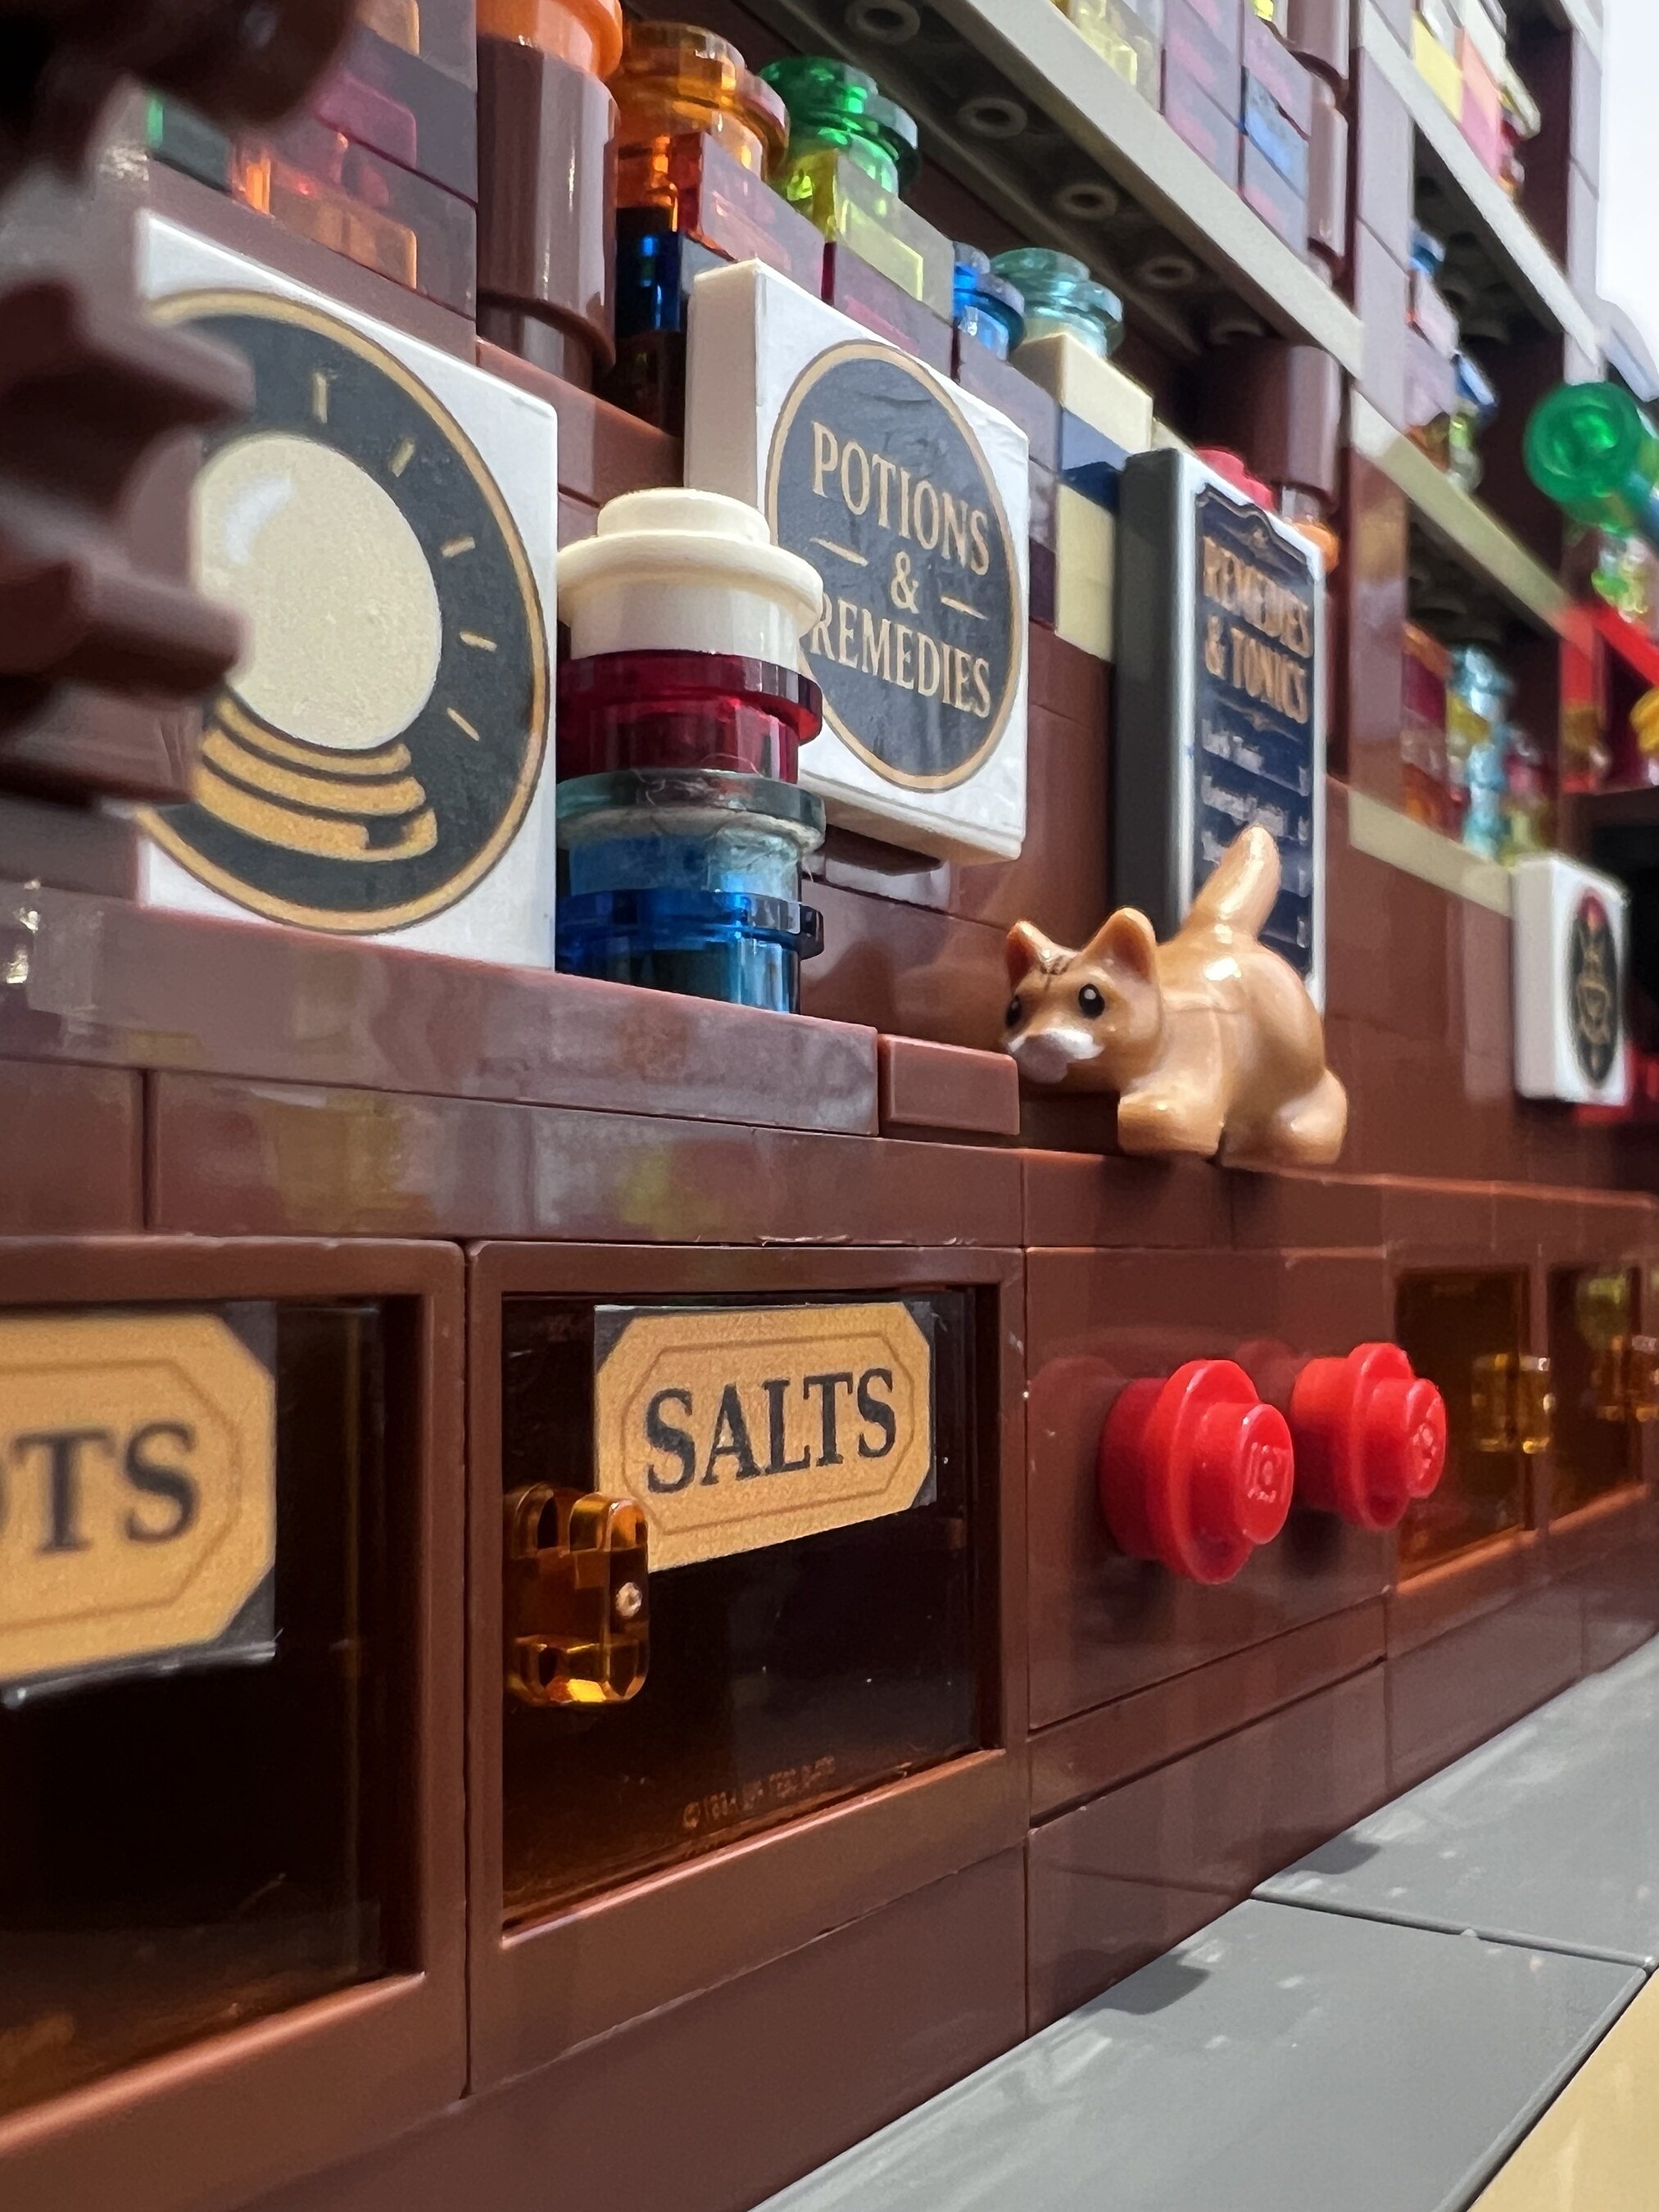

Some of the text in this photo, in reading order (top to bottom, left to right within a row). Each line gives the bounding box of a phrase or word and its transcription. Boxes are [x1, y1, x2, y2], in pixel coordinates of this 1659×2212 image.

[810, 421, 990, 575] POTIONS
[891, 551, 918, 614] &
[809, 592, 990, 718] REMEDIES
[0, 1421, 198, 1555] TS
[646, 1367, 896, 1494] SALTS
